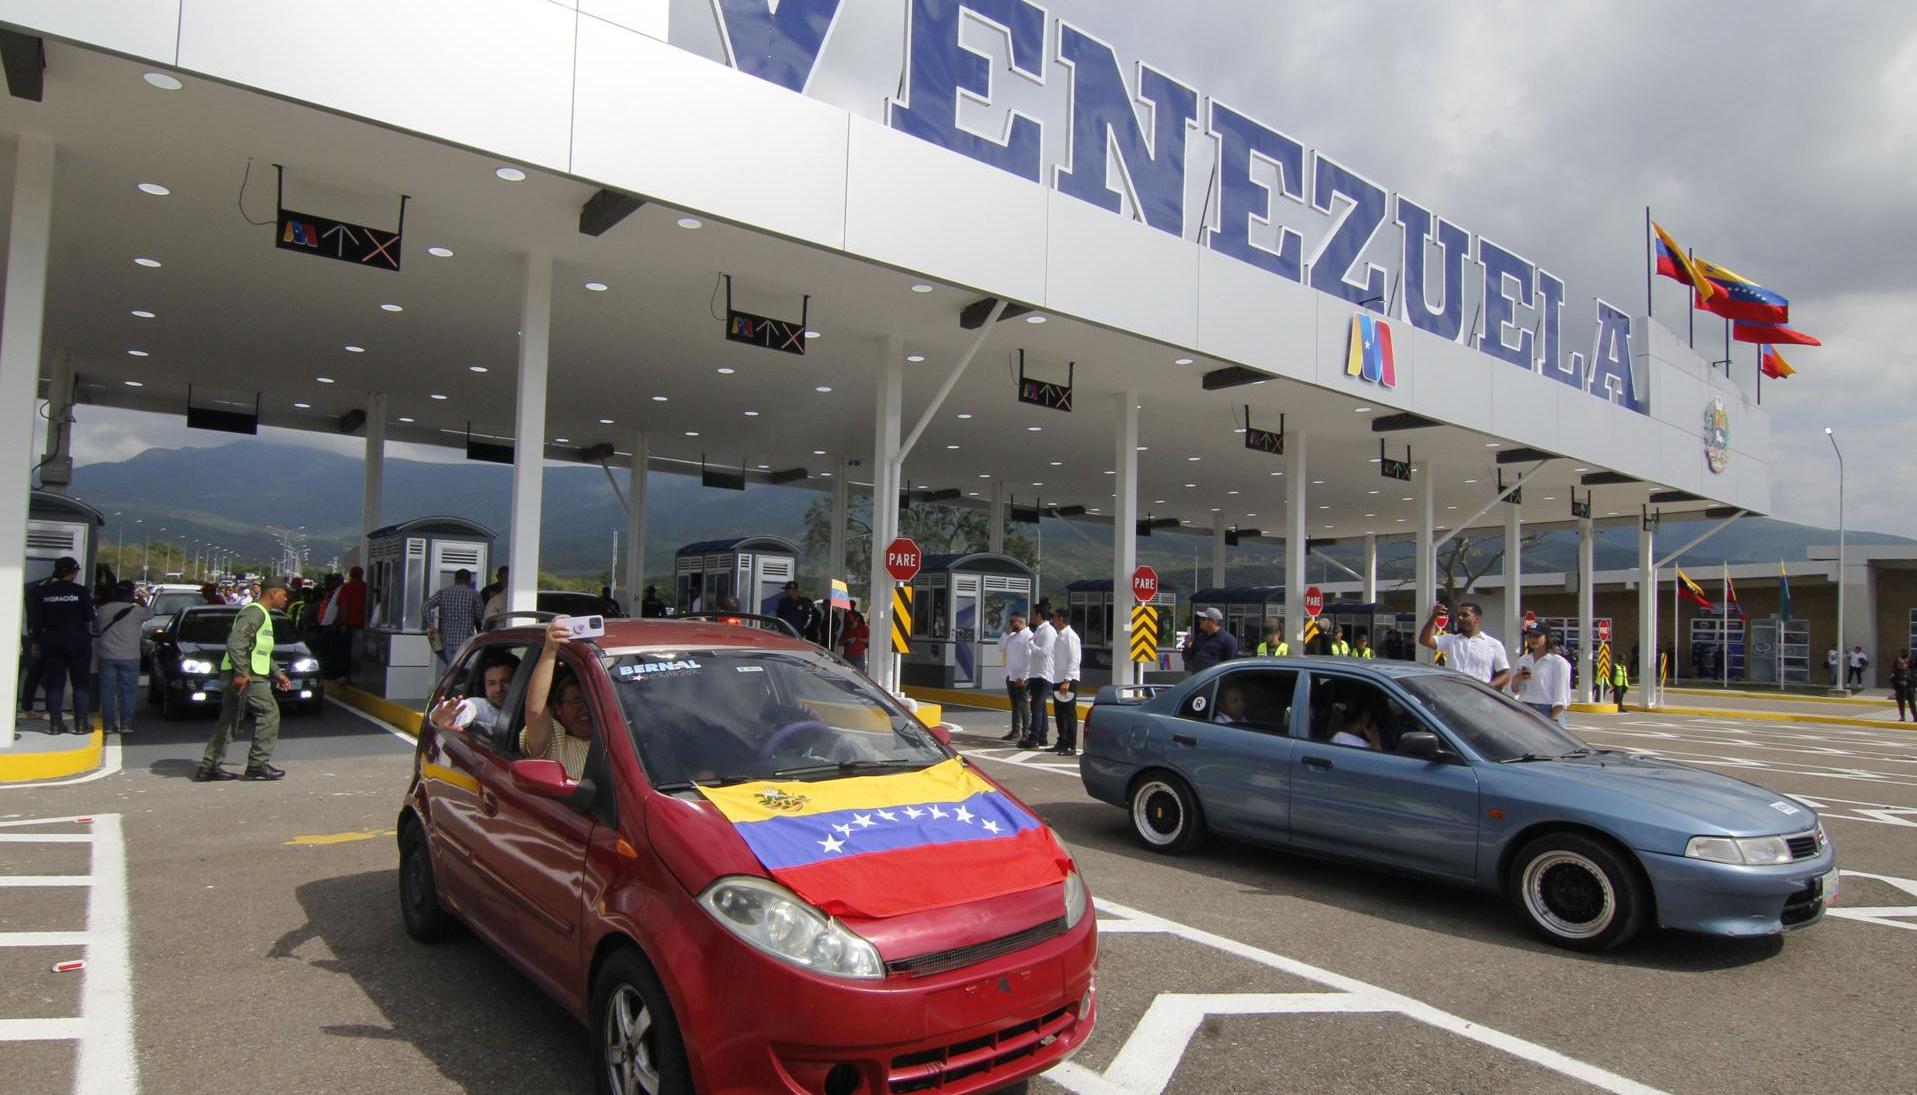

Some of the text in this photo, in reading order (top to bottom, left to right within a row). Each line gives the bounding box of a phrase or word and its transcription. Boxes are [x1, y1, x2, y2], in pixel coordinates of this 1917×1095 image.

[889, 552, 916, 567] PARE
[1134, 577, 1155, 590] PARE
[1306, 596, 1321, 607] PARE
[619, 659, 702, 676] BERNAL
